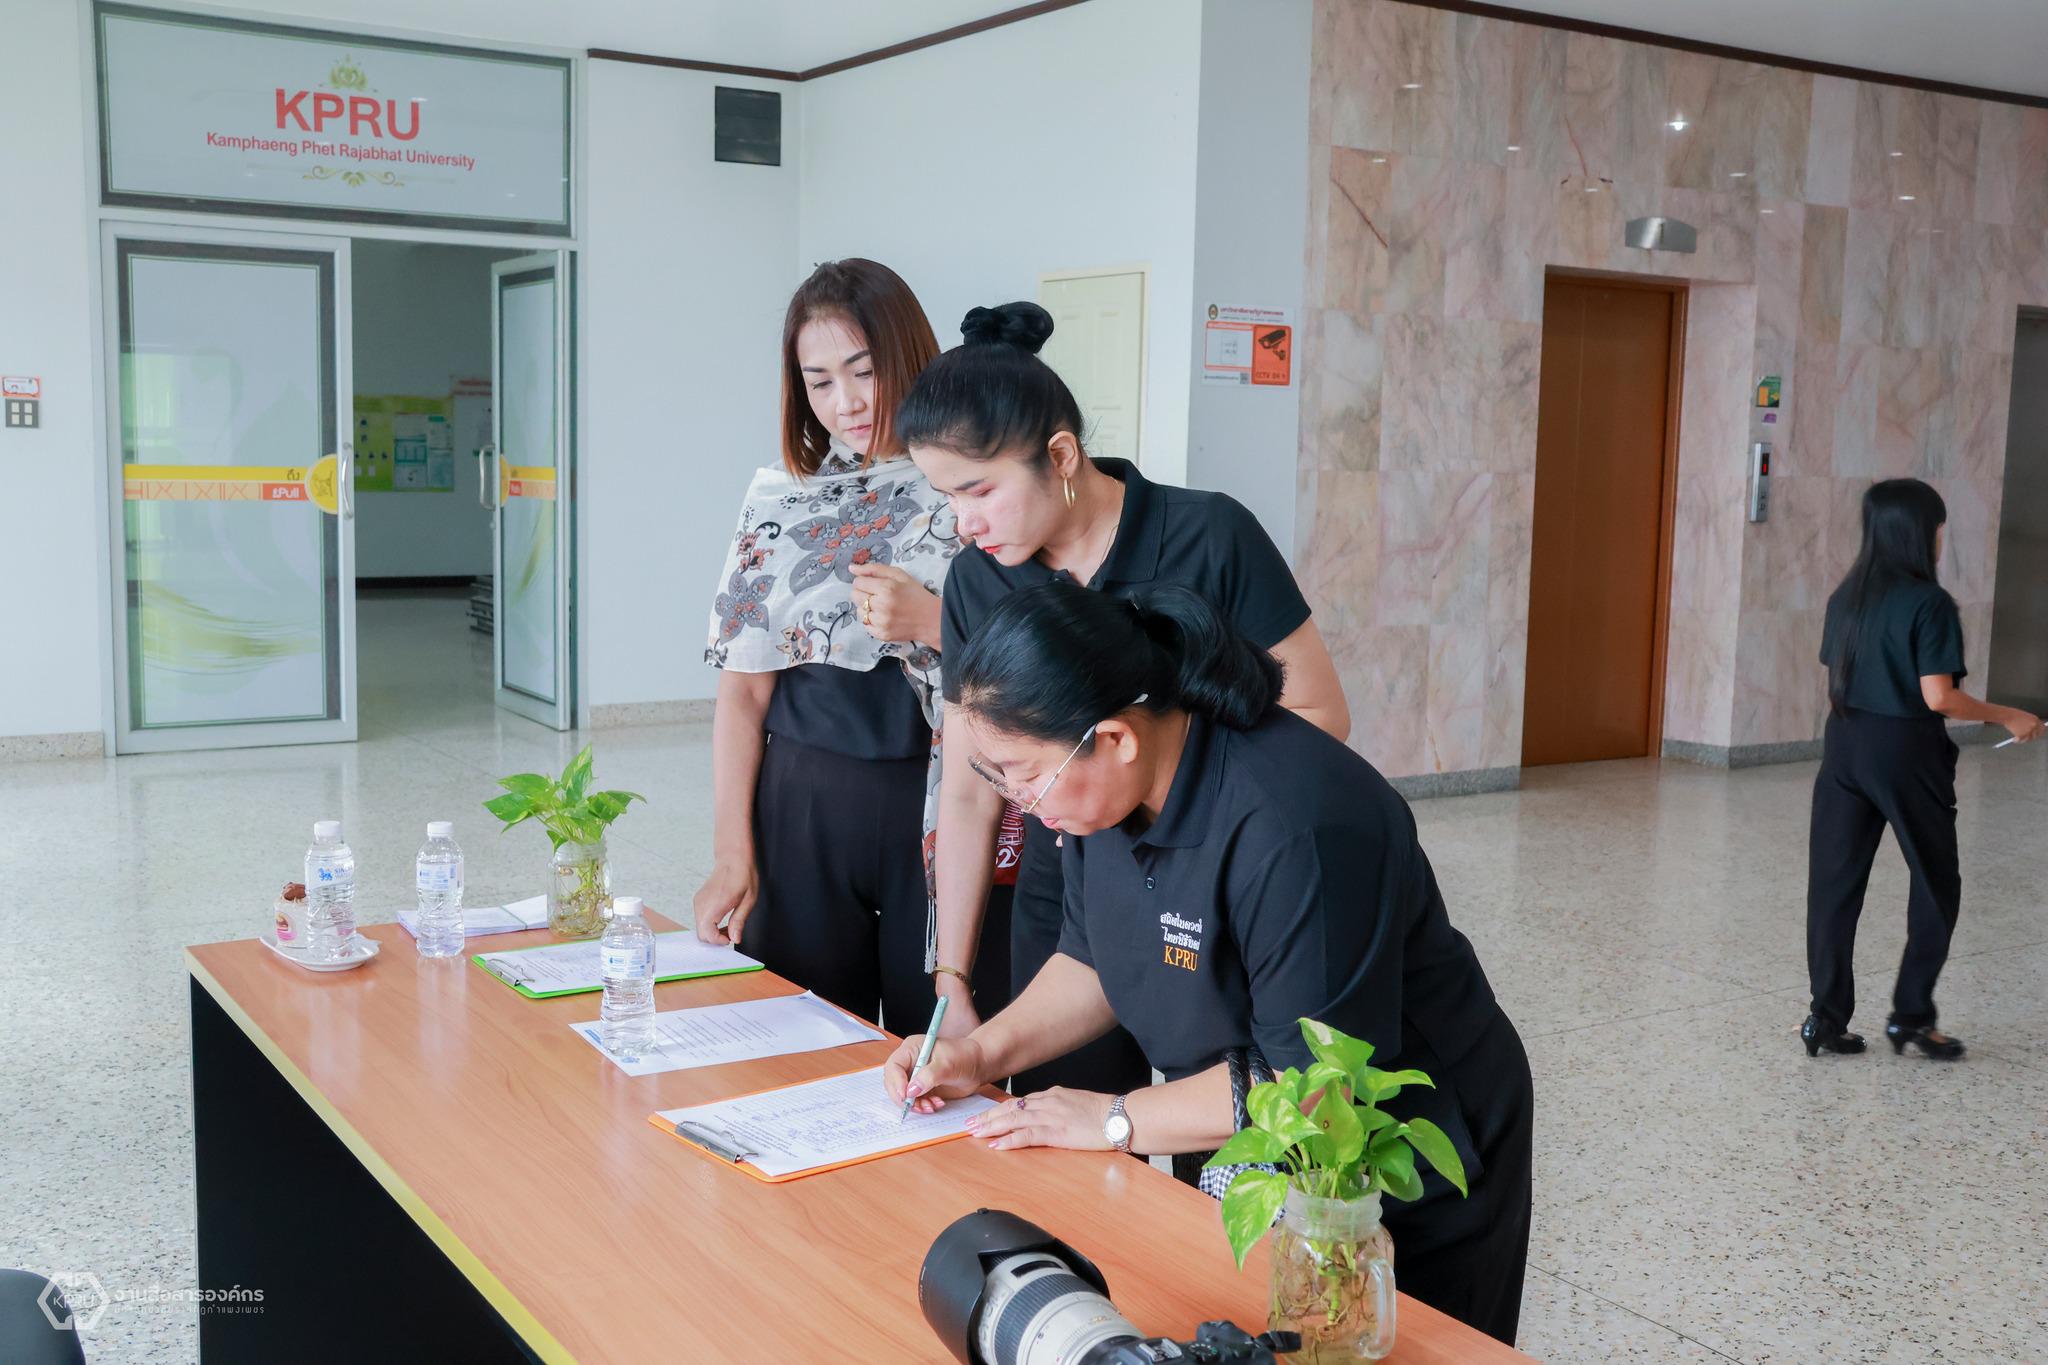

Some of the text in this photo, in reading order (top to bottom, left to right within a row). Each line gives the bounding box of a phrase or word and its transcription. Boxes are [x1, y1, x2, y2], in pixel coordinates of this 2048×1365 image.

[276, 88, 420, 141] KPRU
[207, 132, 475, 171] Kamphaeng Phet Rajabhat University
[1164, 945, 1198, 971] KPRU
